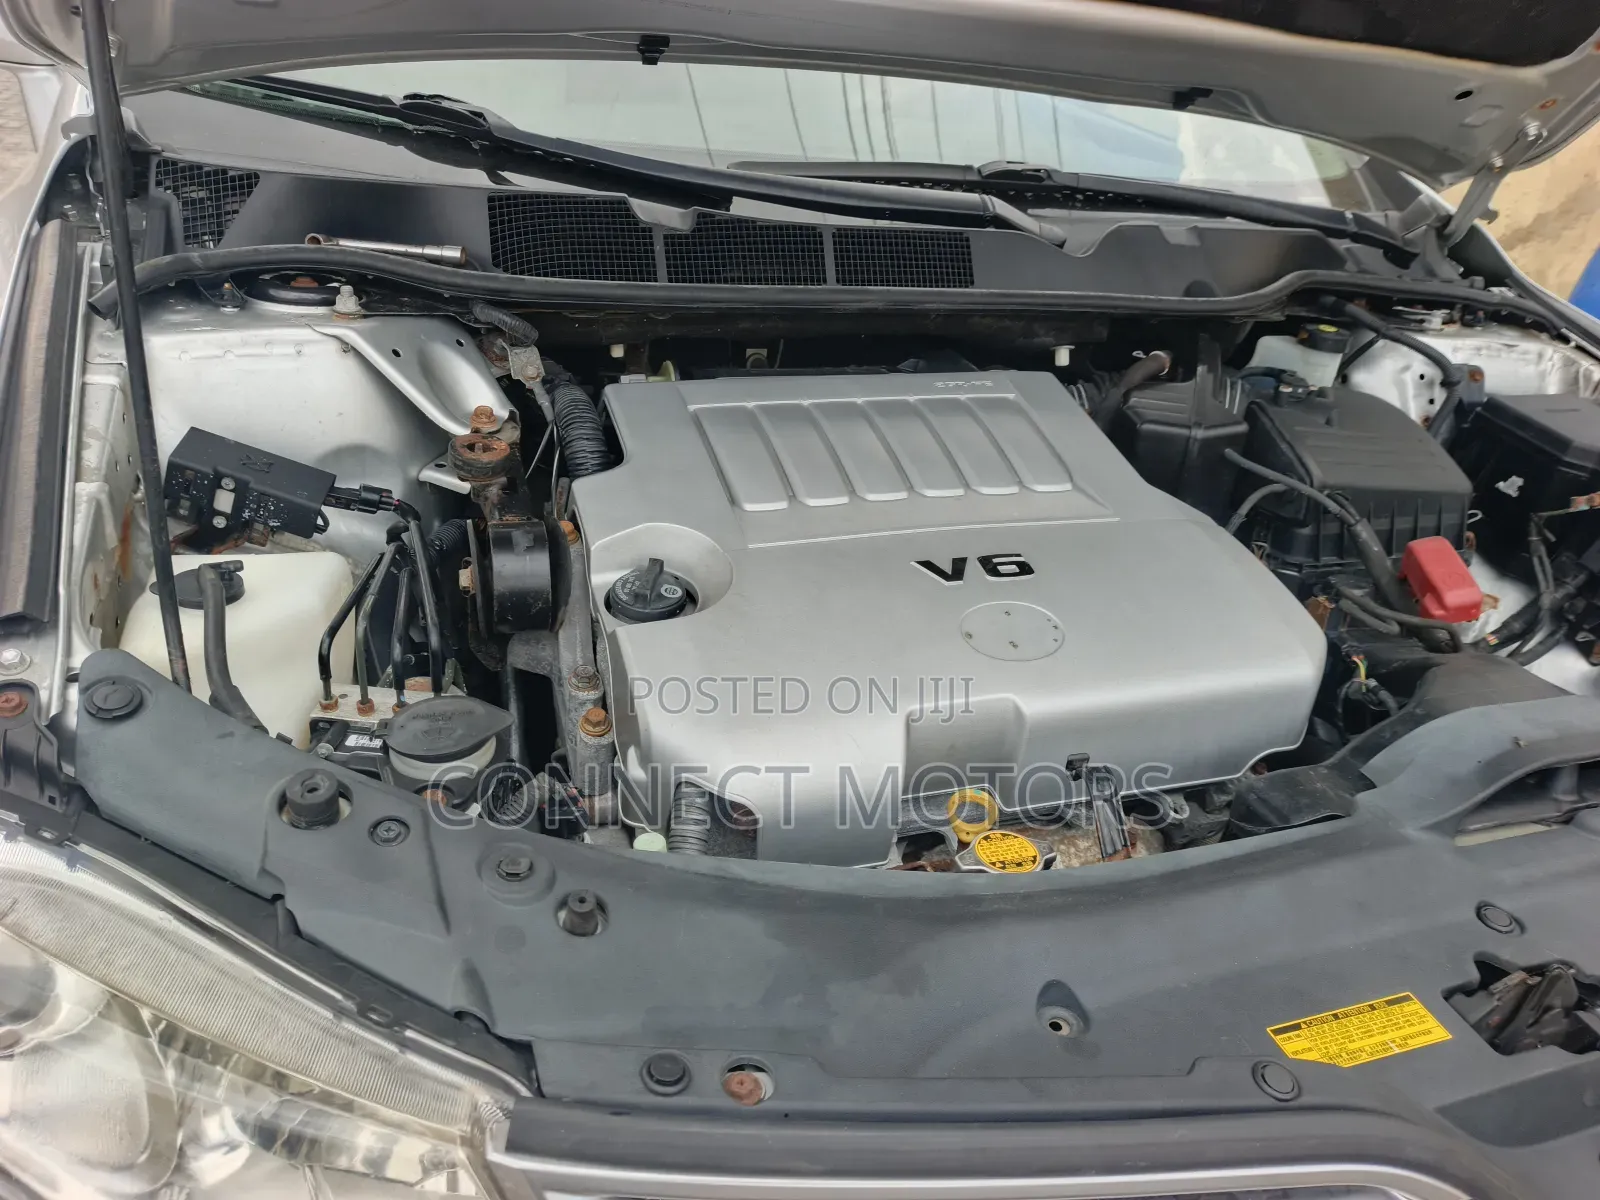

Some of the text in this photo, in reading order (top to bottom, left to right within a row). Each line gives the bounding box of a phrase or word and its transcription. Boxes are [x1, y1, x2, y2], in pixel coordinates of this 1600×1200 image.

[910, 553, 1035, 586] V6
[1306, 1014, 1334, 1028] CAUTION
[1337, 1005, 1372, 1019] ATTENTION
